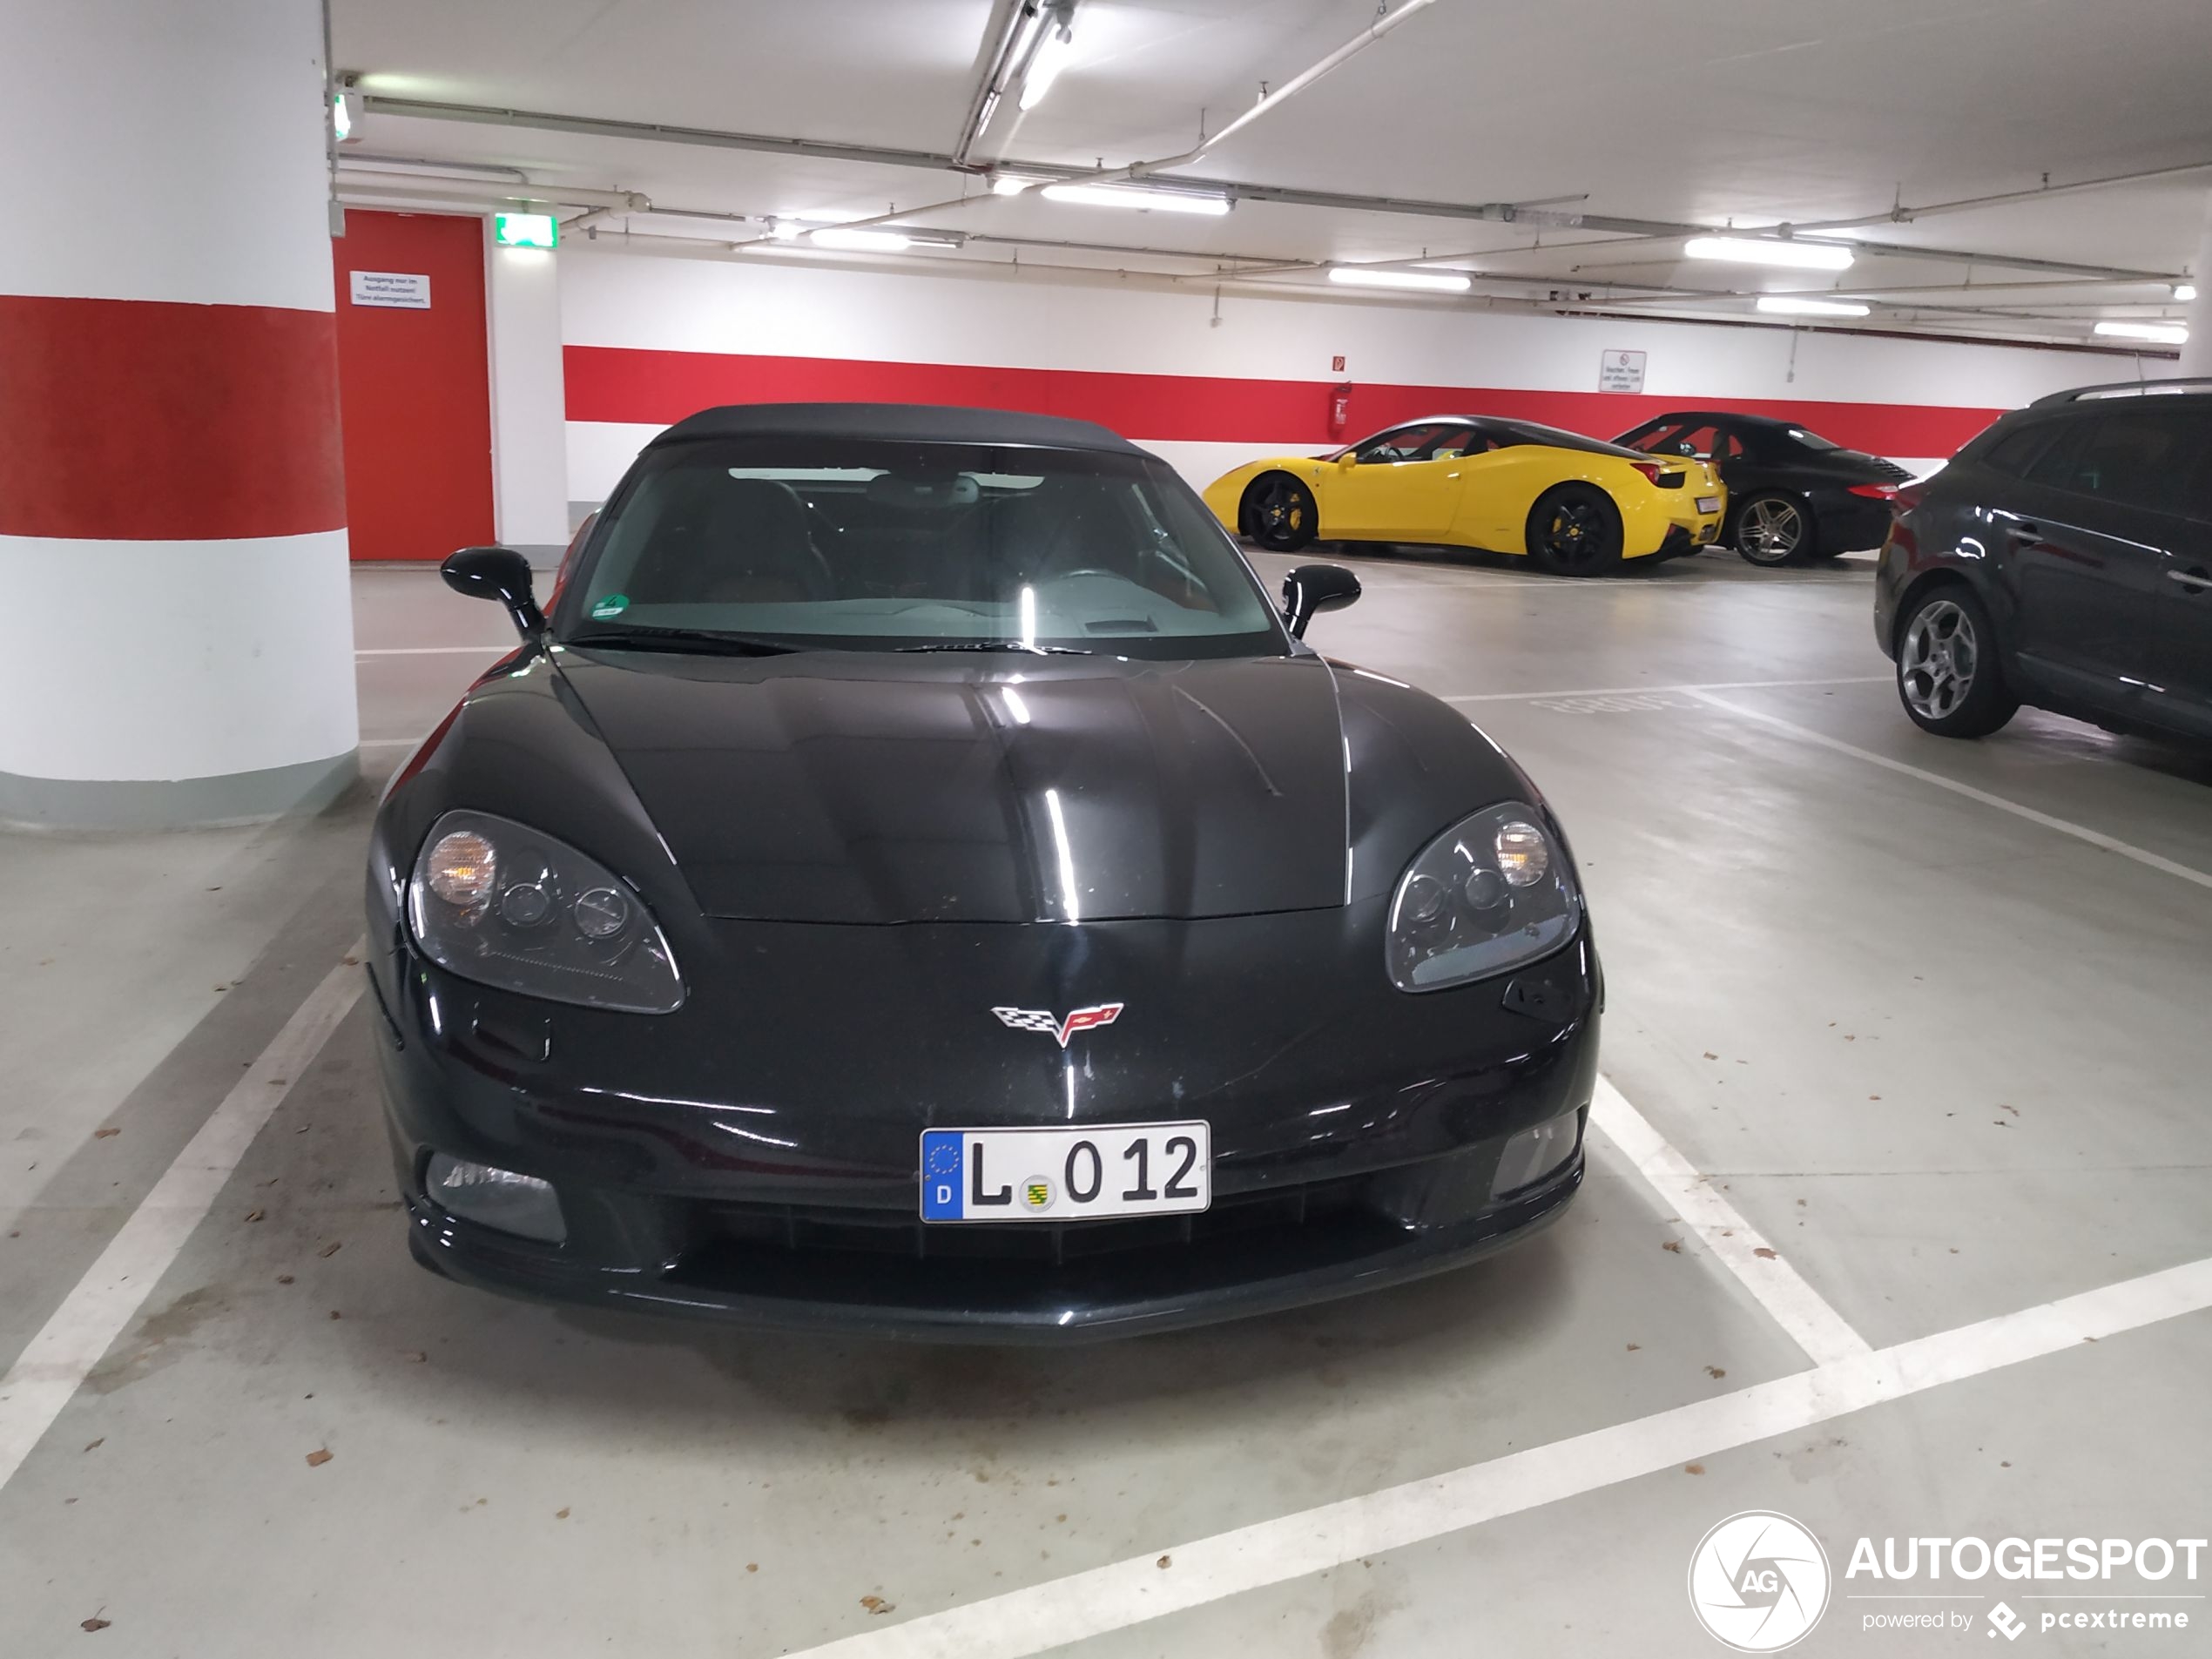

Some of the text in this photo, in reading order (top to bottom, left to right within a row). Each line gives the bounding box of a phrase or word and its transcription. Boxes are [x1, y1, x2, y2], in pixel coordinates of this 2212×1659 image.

[604, 596, 617, 607] 4
[972, 1143, 1012, 1205] L
[1123, 1136, 1198, 1201] 12
[936, 1185, 952, 1204] D
